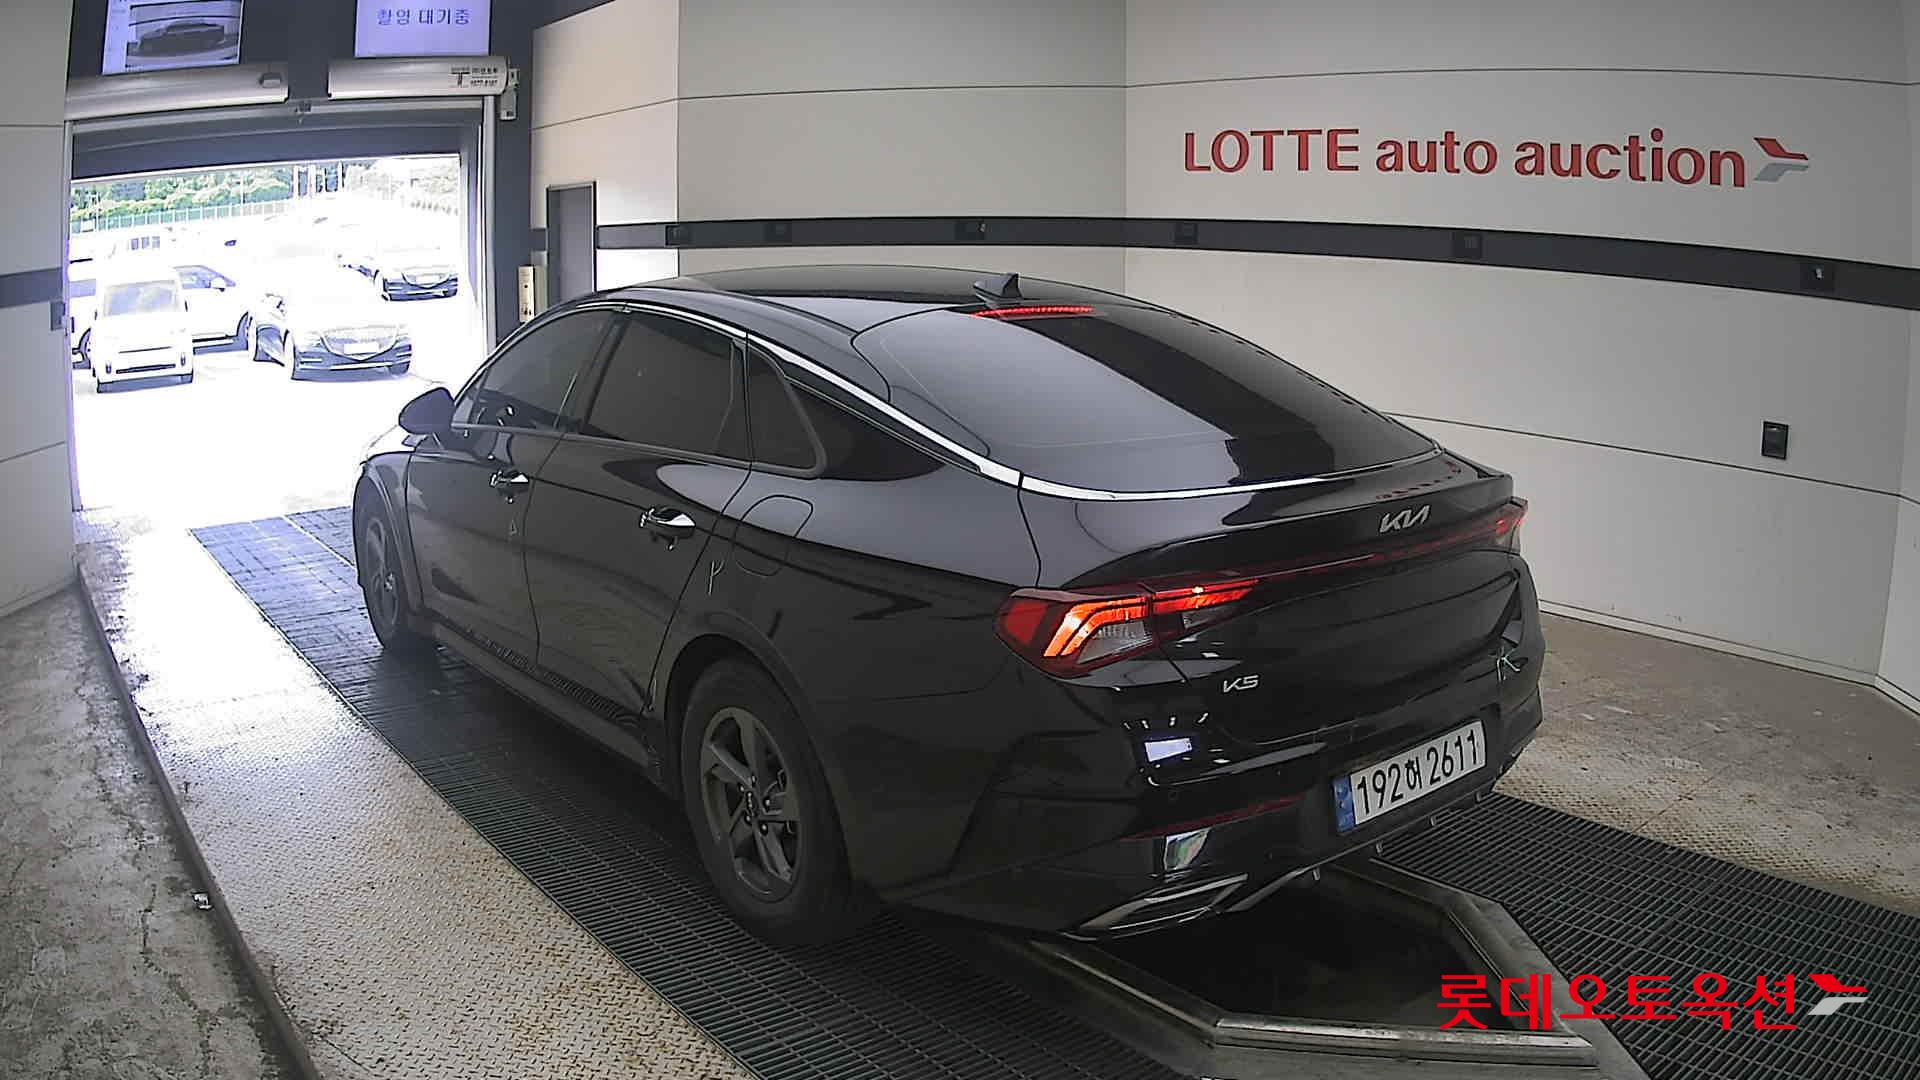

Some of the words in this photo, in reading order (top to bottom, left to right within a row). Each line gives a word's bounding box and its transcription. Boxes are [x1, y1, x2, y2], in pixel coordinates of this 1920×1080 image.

[418, 8, 470, 25] 대기중
[1184, 128, 1360, 173] LOTTE
[1376, 131, 1498, 175] auto
[1515, 128, 1746, 188] auction
[1222, 674, 1260, 694] K5
[1357, 756, 1423, 816] 192허
[1426, 728, 1478, 787] 2611
